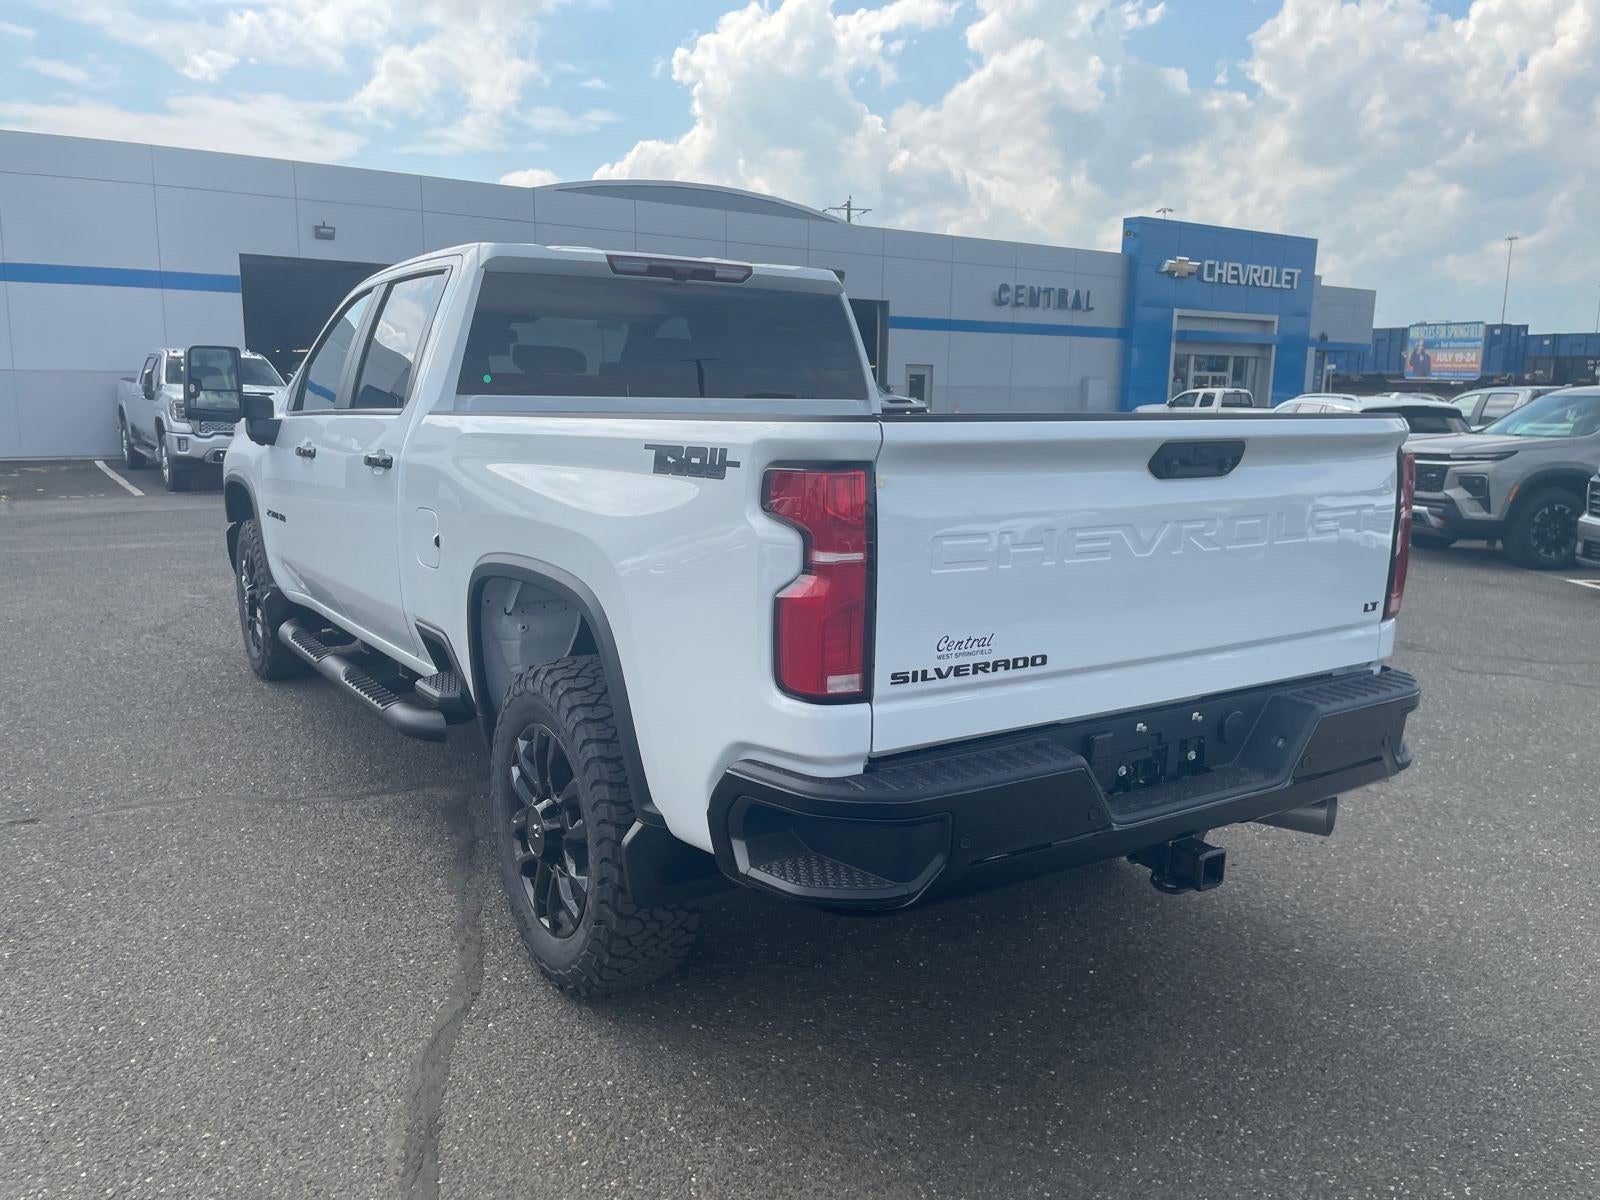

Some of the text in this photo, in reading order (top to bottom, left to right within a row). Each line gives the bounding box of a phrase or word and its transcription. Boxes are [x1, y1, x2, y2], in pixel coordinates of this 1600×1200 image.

[1203, 260, 1301, 290] CHEVROLET
[994, 283, 1095, 312] CENTRAL
[1436, 352, 1453, 363] JULY
[930, 504, 1376, 574] CHEVROLET
[1363, 601, 1379, 613] LT
[936, 632, 995, 652] Central
[936, 649, 993, 661] WEST SPRINGFIELD
[890, 654, 1048, 685] SILVERADO
